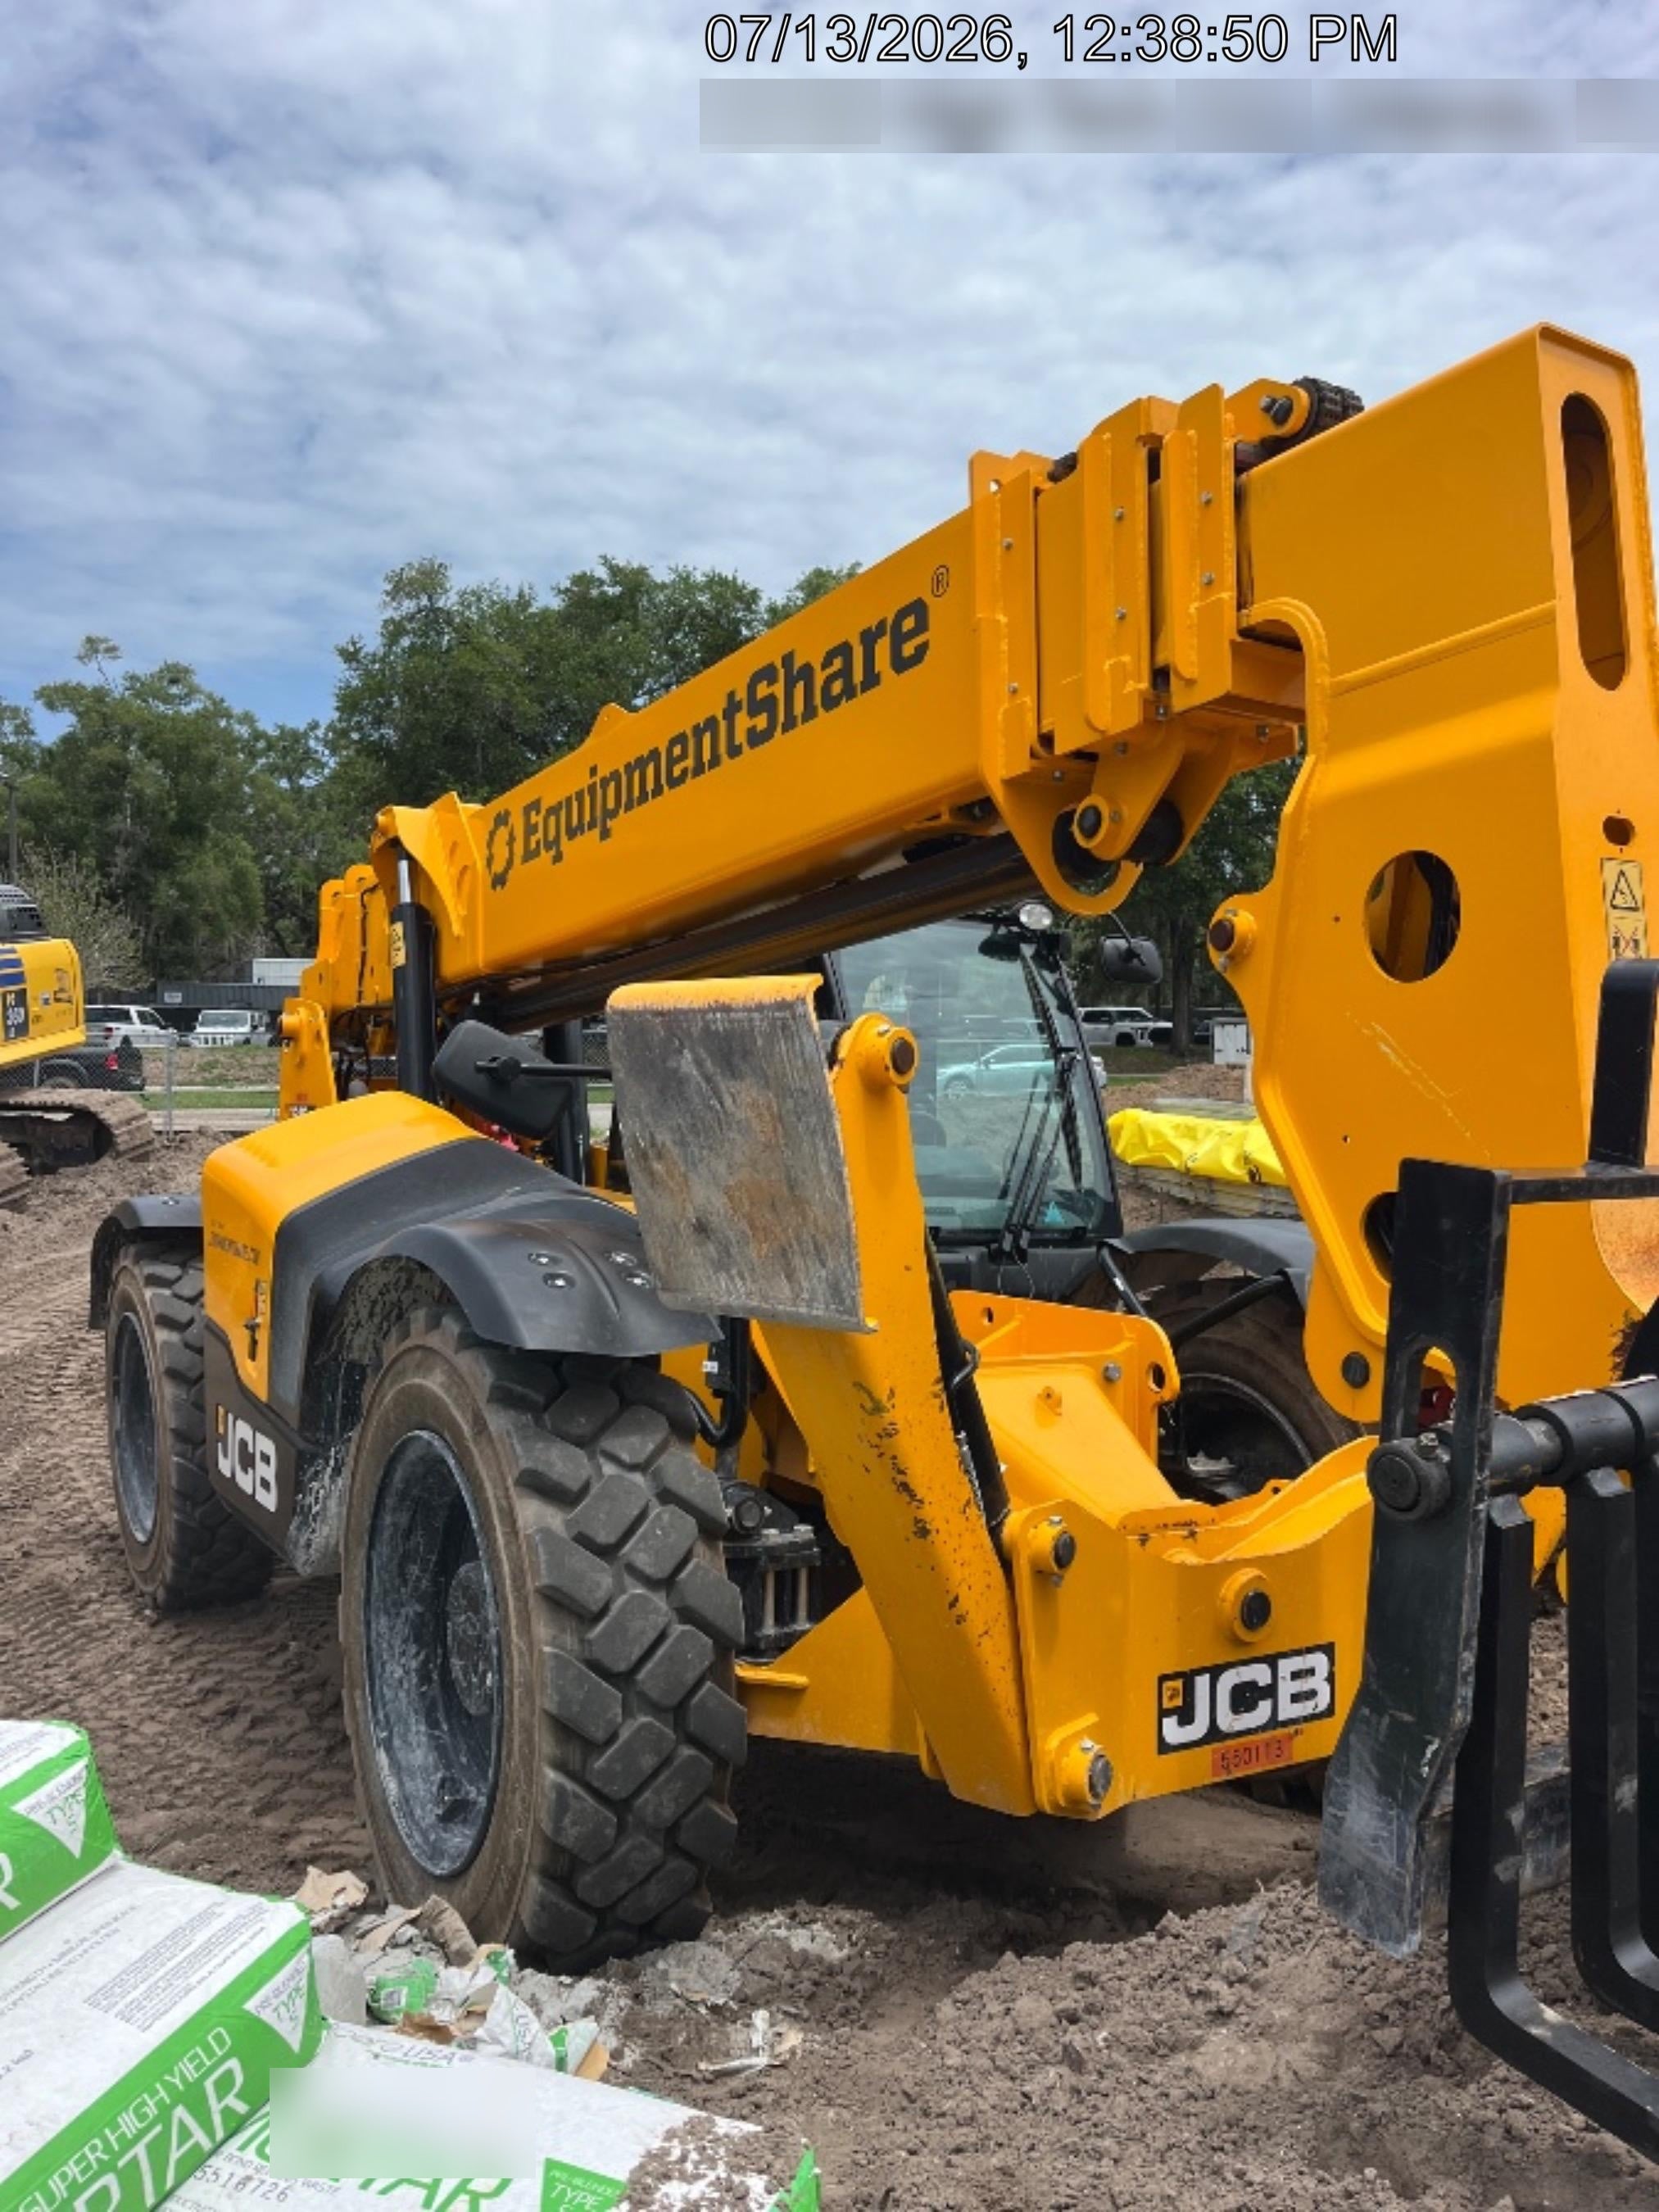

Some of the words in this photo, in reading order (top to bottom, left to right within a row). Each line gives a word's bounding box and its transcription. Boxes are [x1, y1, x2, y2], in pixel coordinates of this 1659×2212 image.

[521, 596, 930, 865] EquipmentShare
[217, 1412, 277, 1513] JCB
[1162, 1652, 1331, 1745] JCB
[18, 2137, 111, 2212] SUPER
[104, 2082, 170, 2151] HIGH
[163, 2027, 232, 2091] YIELD
